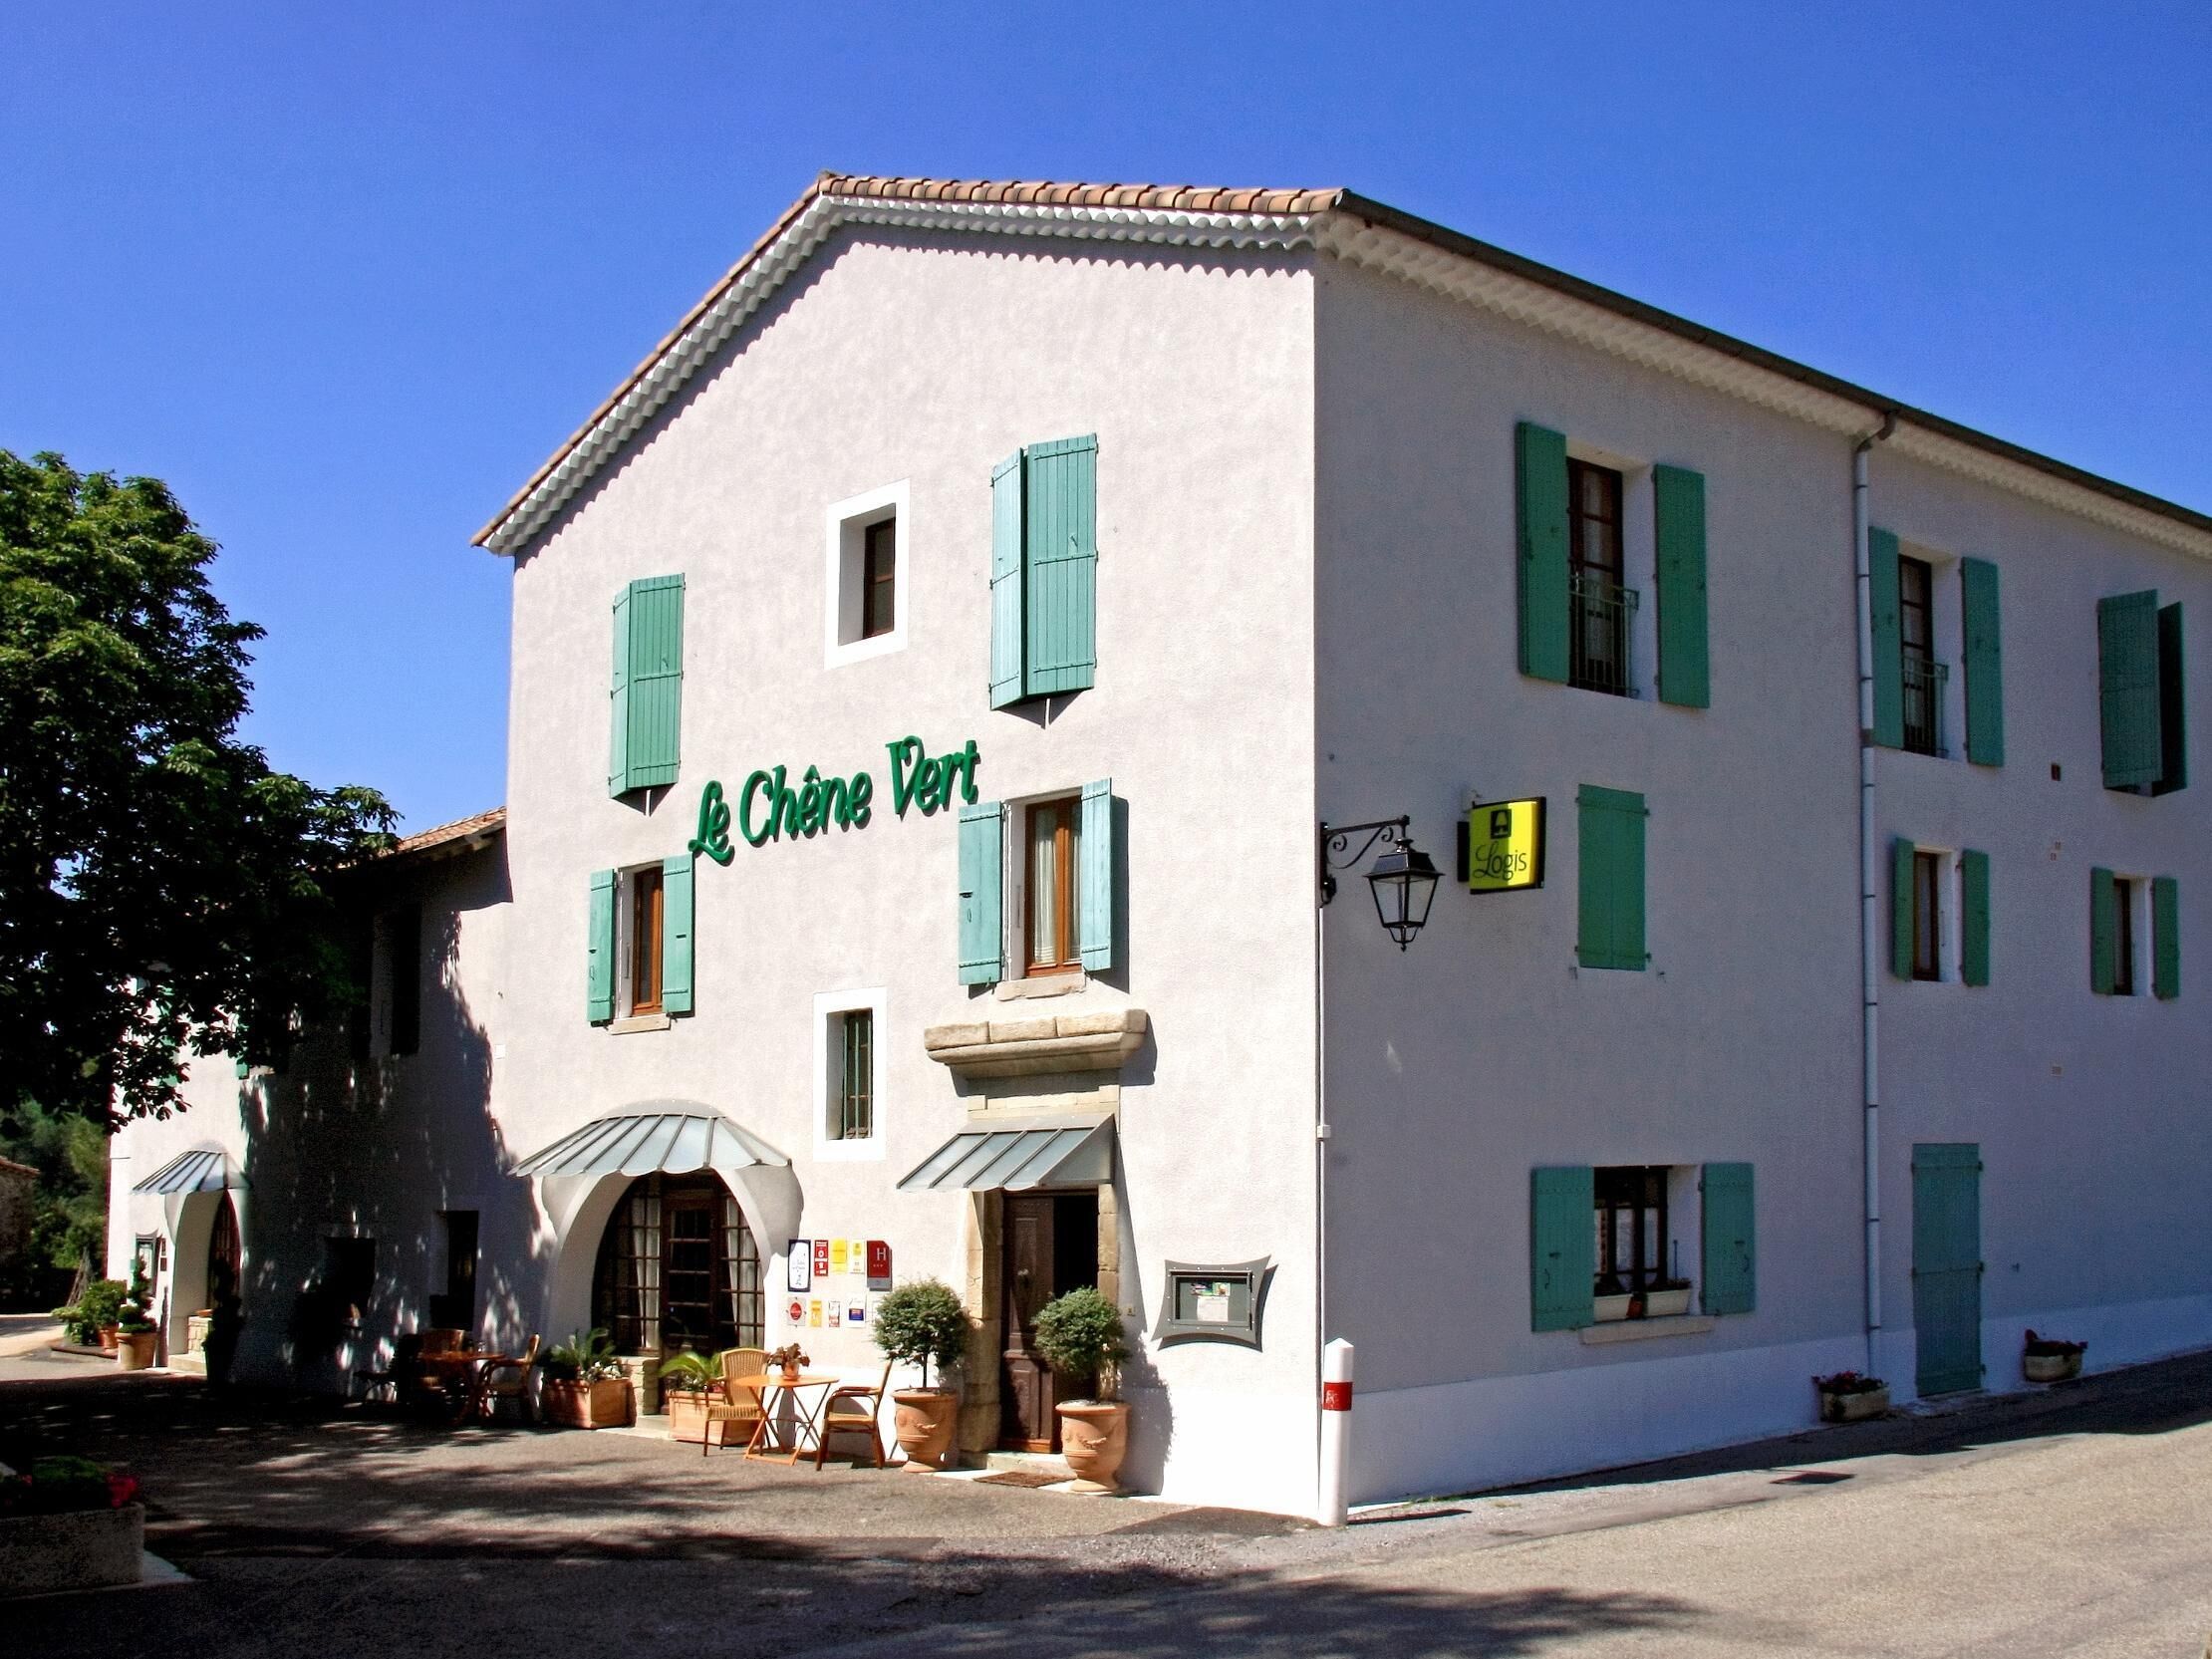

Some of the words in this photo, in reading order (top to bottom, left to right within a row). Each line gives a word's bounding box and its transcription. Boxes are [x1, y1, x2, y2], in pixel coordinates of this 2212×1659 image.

[688, 780, 733, 864] Le
[740, 764, 872, 846] Chêne
[885, 735, 979, 818] Vert
[1473, 841, 1526, 881] Logis
[876, 1247, 887, 1261] H
